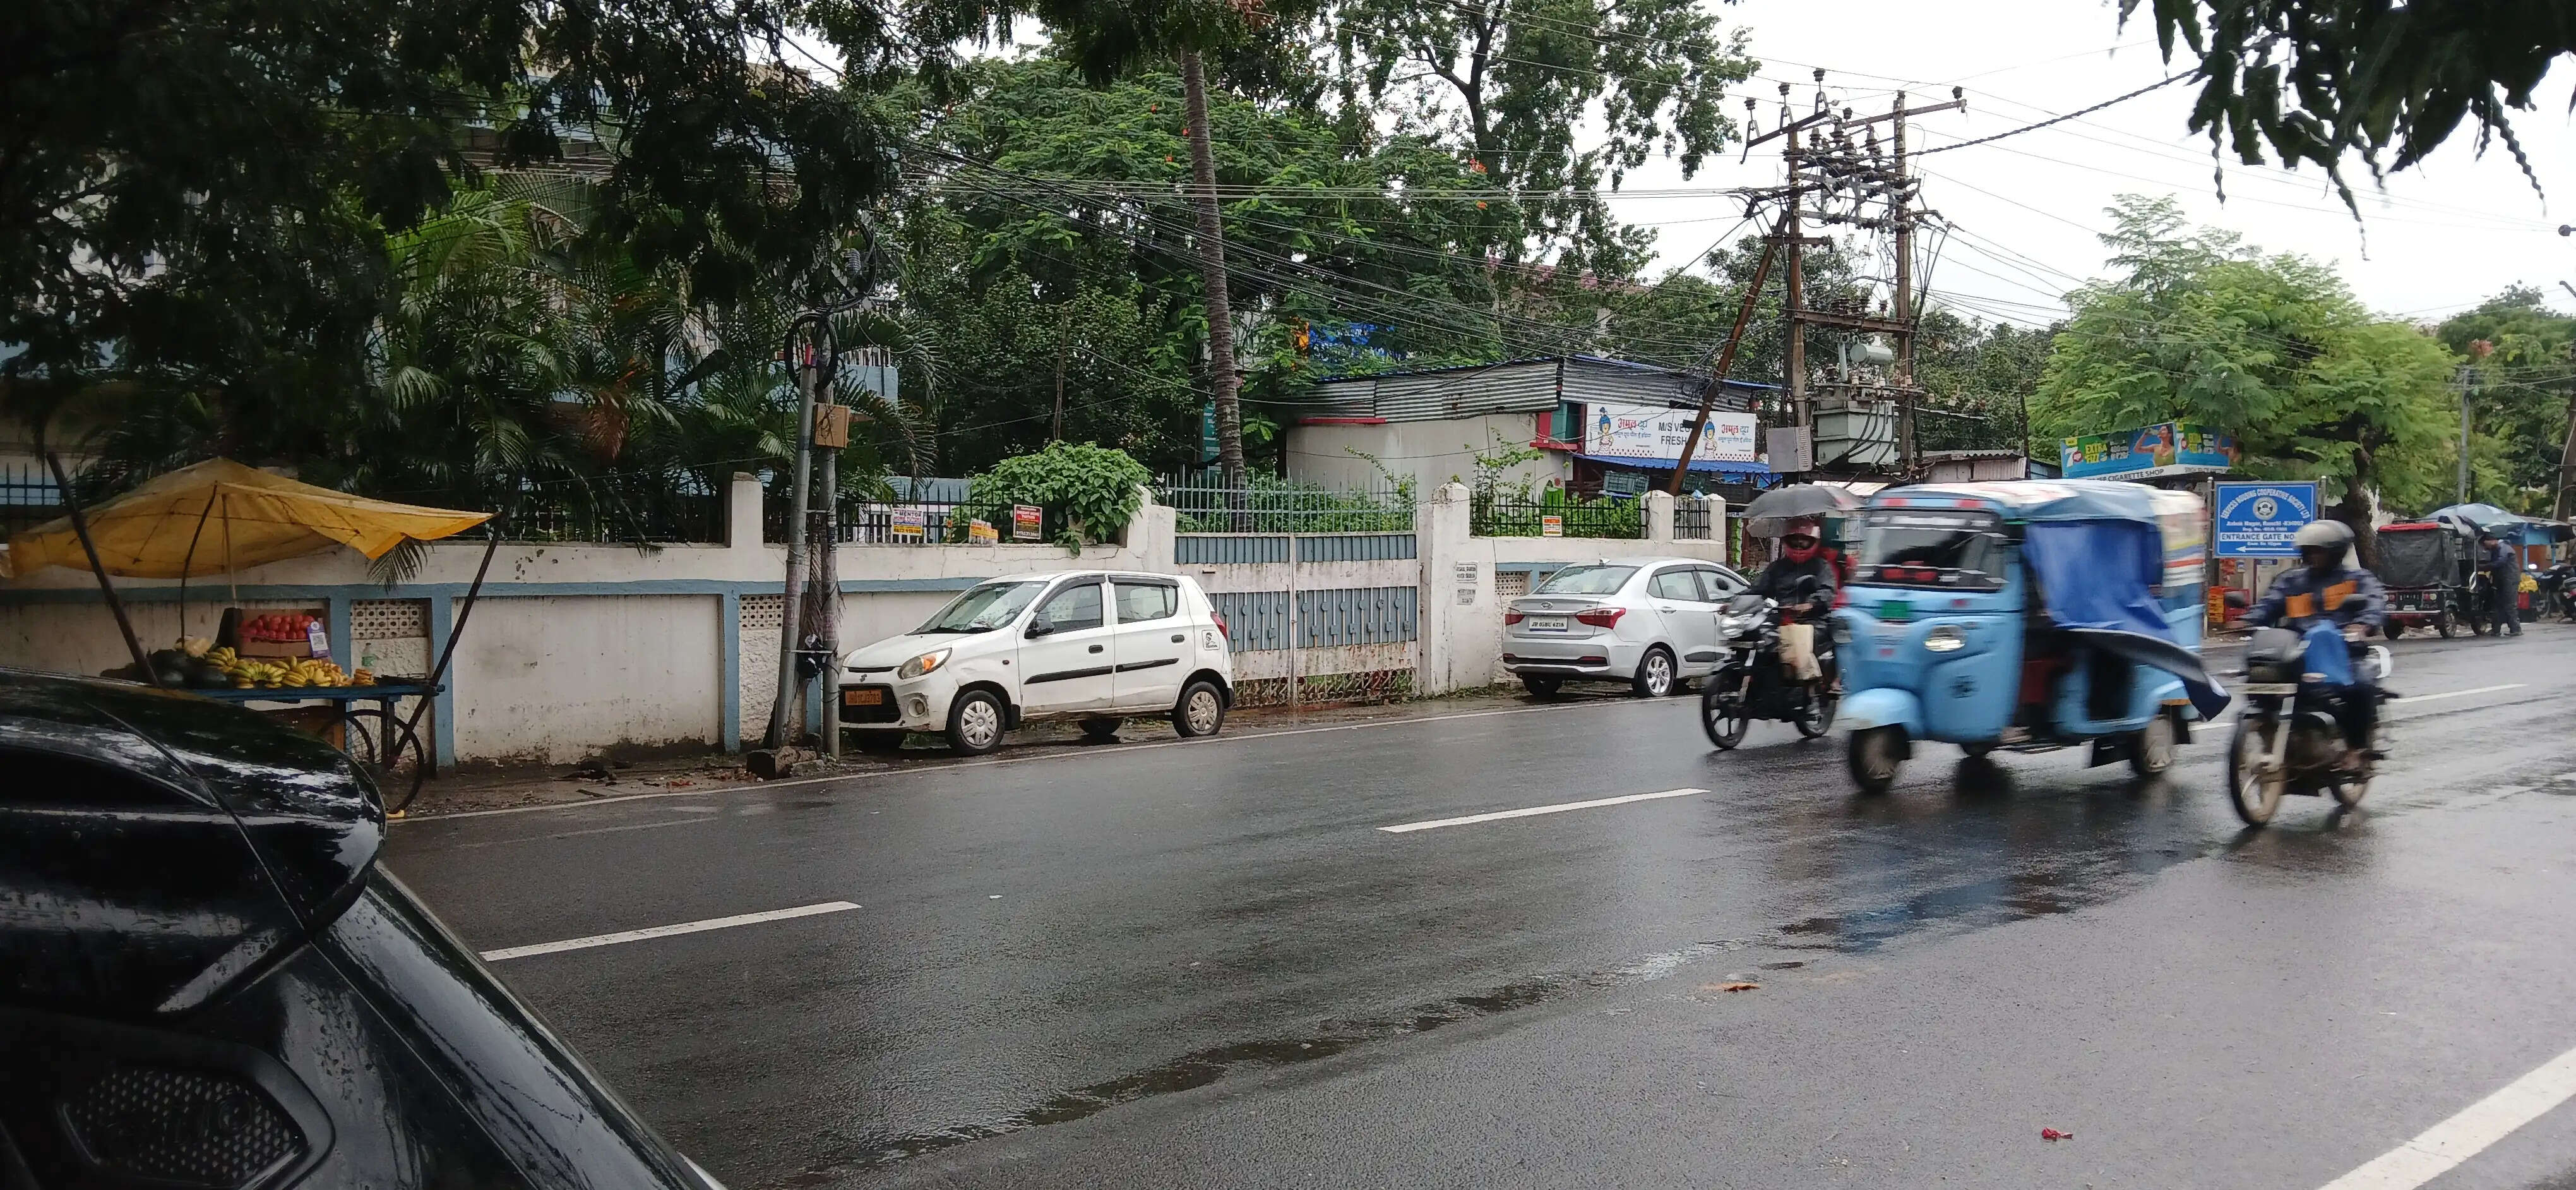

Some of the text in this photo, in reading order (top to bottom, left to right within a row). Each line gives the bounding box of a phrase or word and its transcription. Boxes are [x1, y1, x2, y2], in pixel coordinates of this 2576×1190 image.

[1658, 422, 1673, 431] M/S
[1722, 424, 1738, 435] अमूल
[1661, 436, 1687, 445] FRESH
[2108, 471, 2144, 481] CIGARETTE
